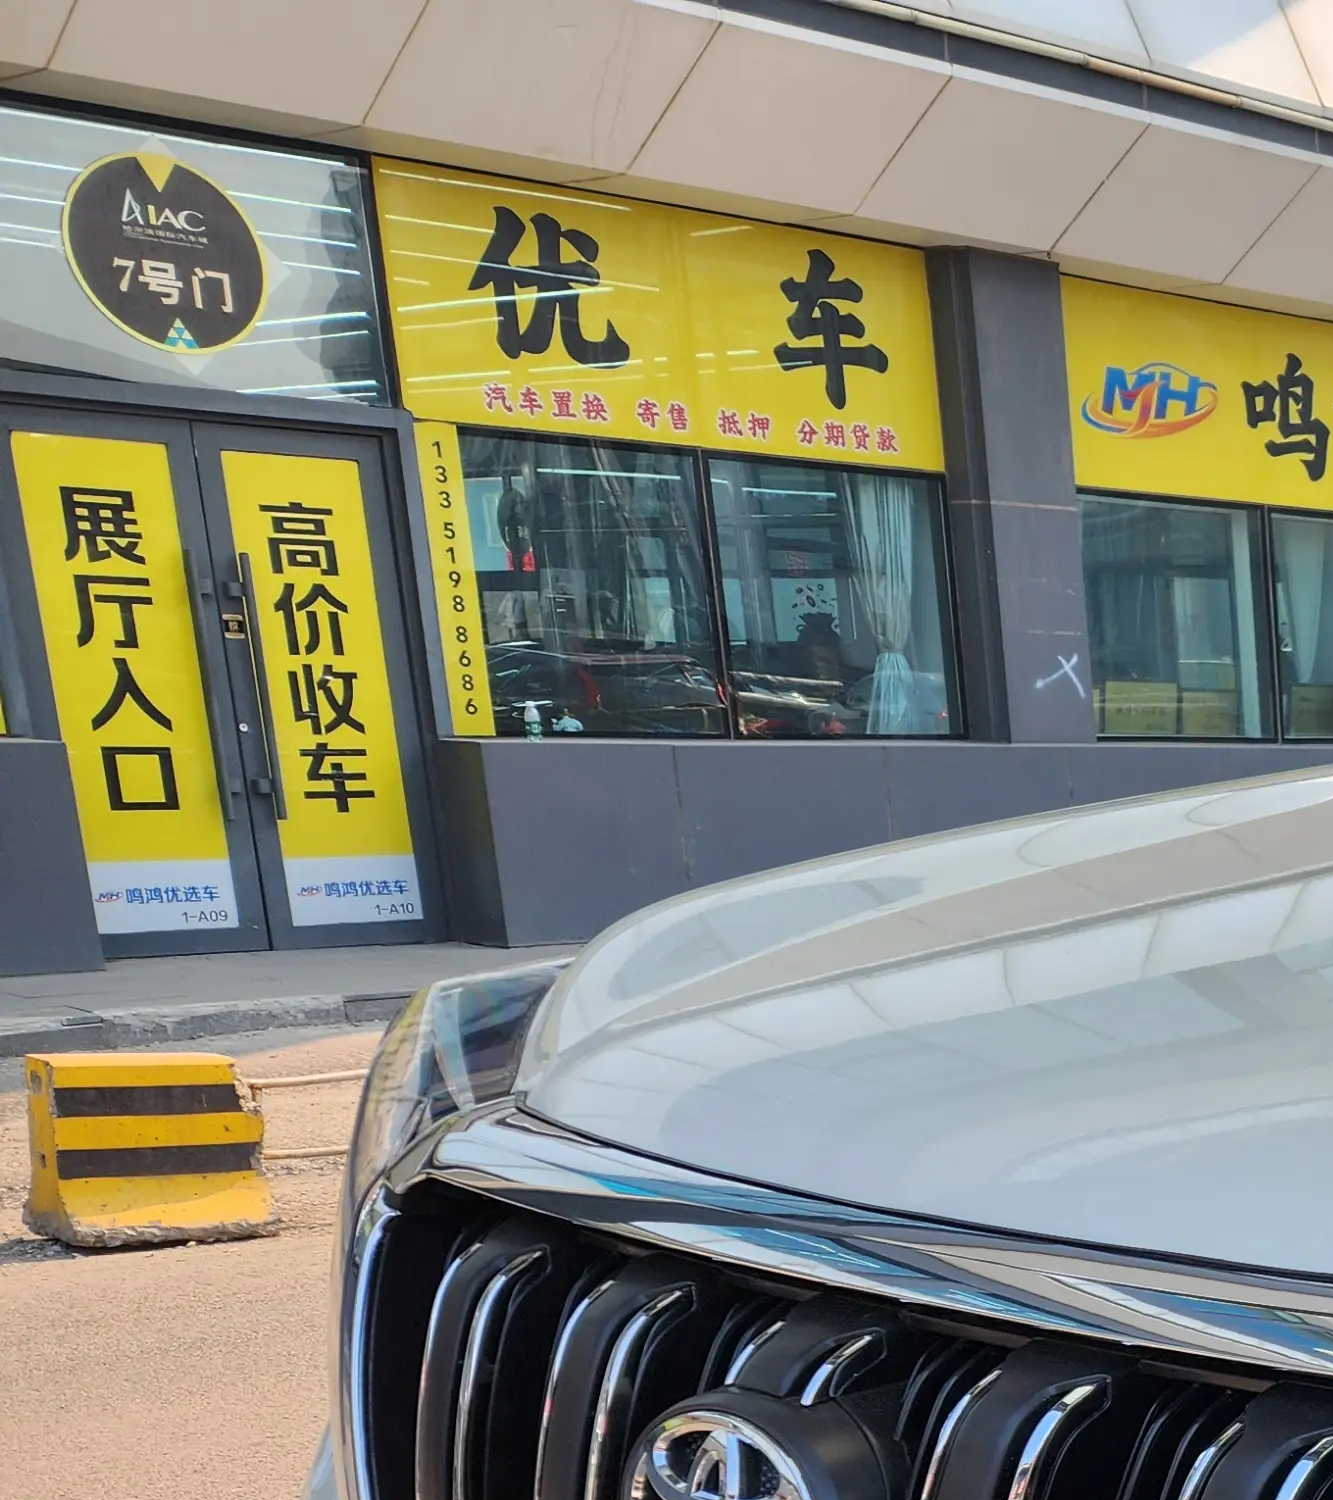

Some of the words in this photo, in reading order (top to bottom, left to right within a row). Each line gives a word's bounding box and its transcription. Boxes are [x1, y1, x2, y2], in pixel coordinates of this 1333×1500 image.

[112, 256, 235, 314] 7号门
[483, 382, 610, 424] 汽车置换
[636, 398, 690, 431] 寄售
[717, 409, 772, 441] 抵押
[796, 419, 900, 455] 分期贷款
[58, 485, 182, 811] 展厅入口
[258, 501, 375, 813] 高价收车
[125, 885, 221, 904] 鸣鸿优选车
[324, 880, 411, 898] 鸣鸿优选车
[181, 909, 229, 923] 1-A09
[374, 902, 415, 916] 1-A10
